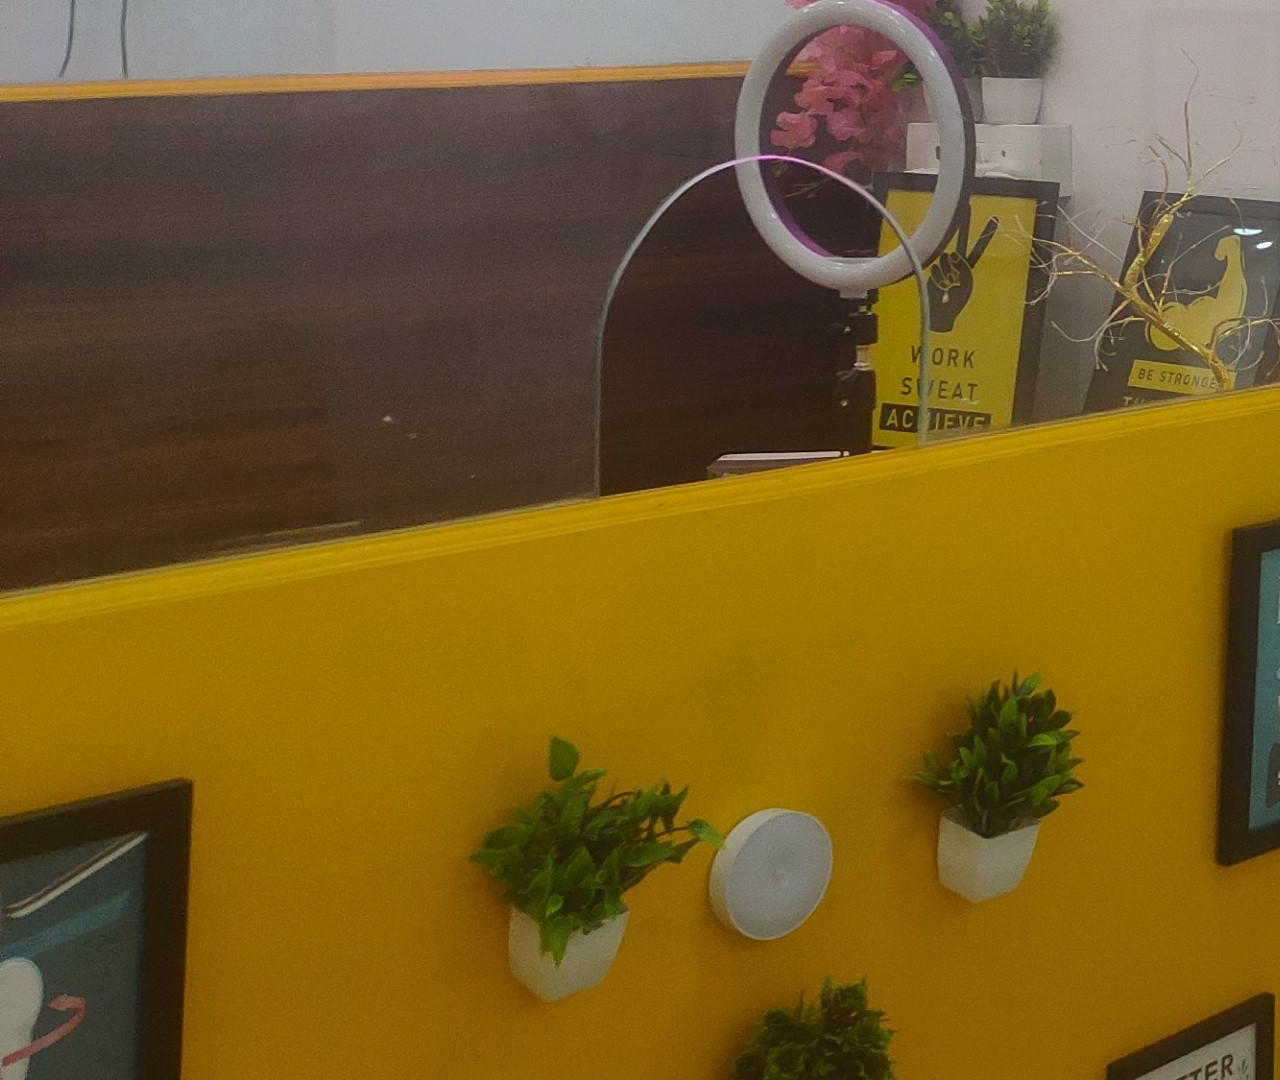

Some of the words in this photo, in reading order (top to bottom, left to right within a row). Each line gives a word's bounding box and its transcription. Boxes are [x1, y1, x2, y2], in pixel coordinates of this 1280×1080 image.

[911, 345, 976, 368] WORK
[900, 377, 978, 401] SWEAT
[1138, 367, 1153, 381] BE
[1159, 370, 1218, 389] STRONGE
[886, 408, 986, 431] ACIEVE
